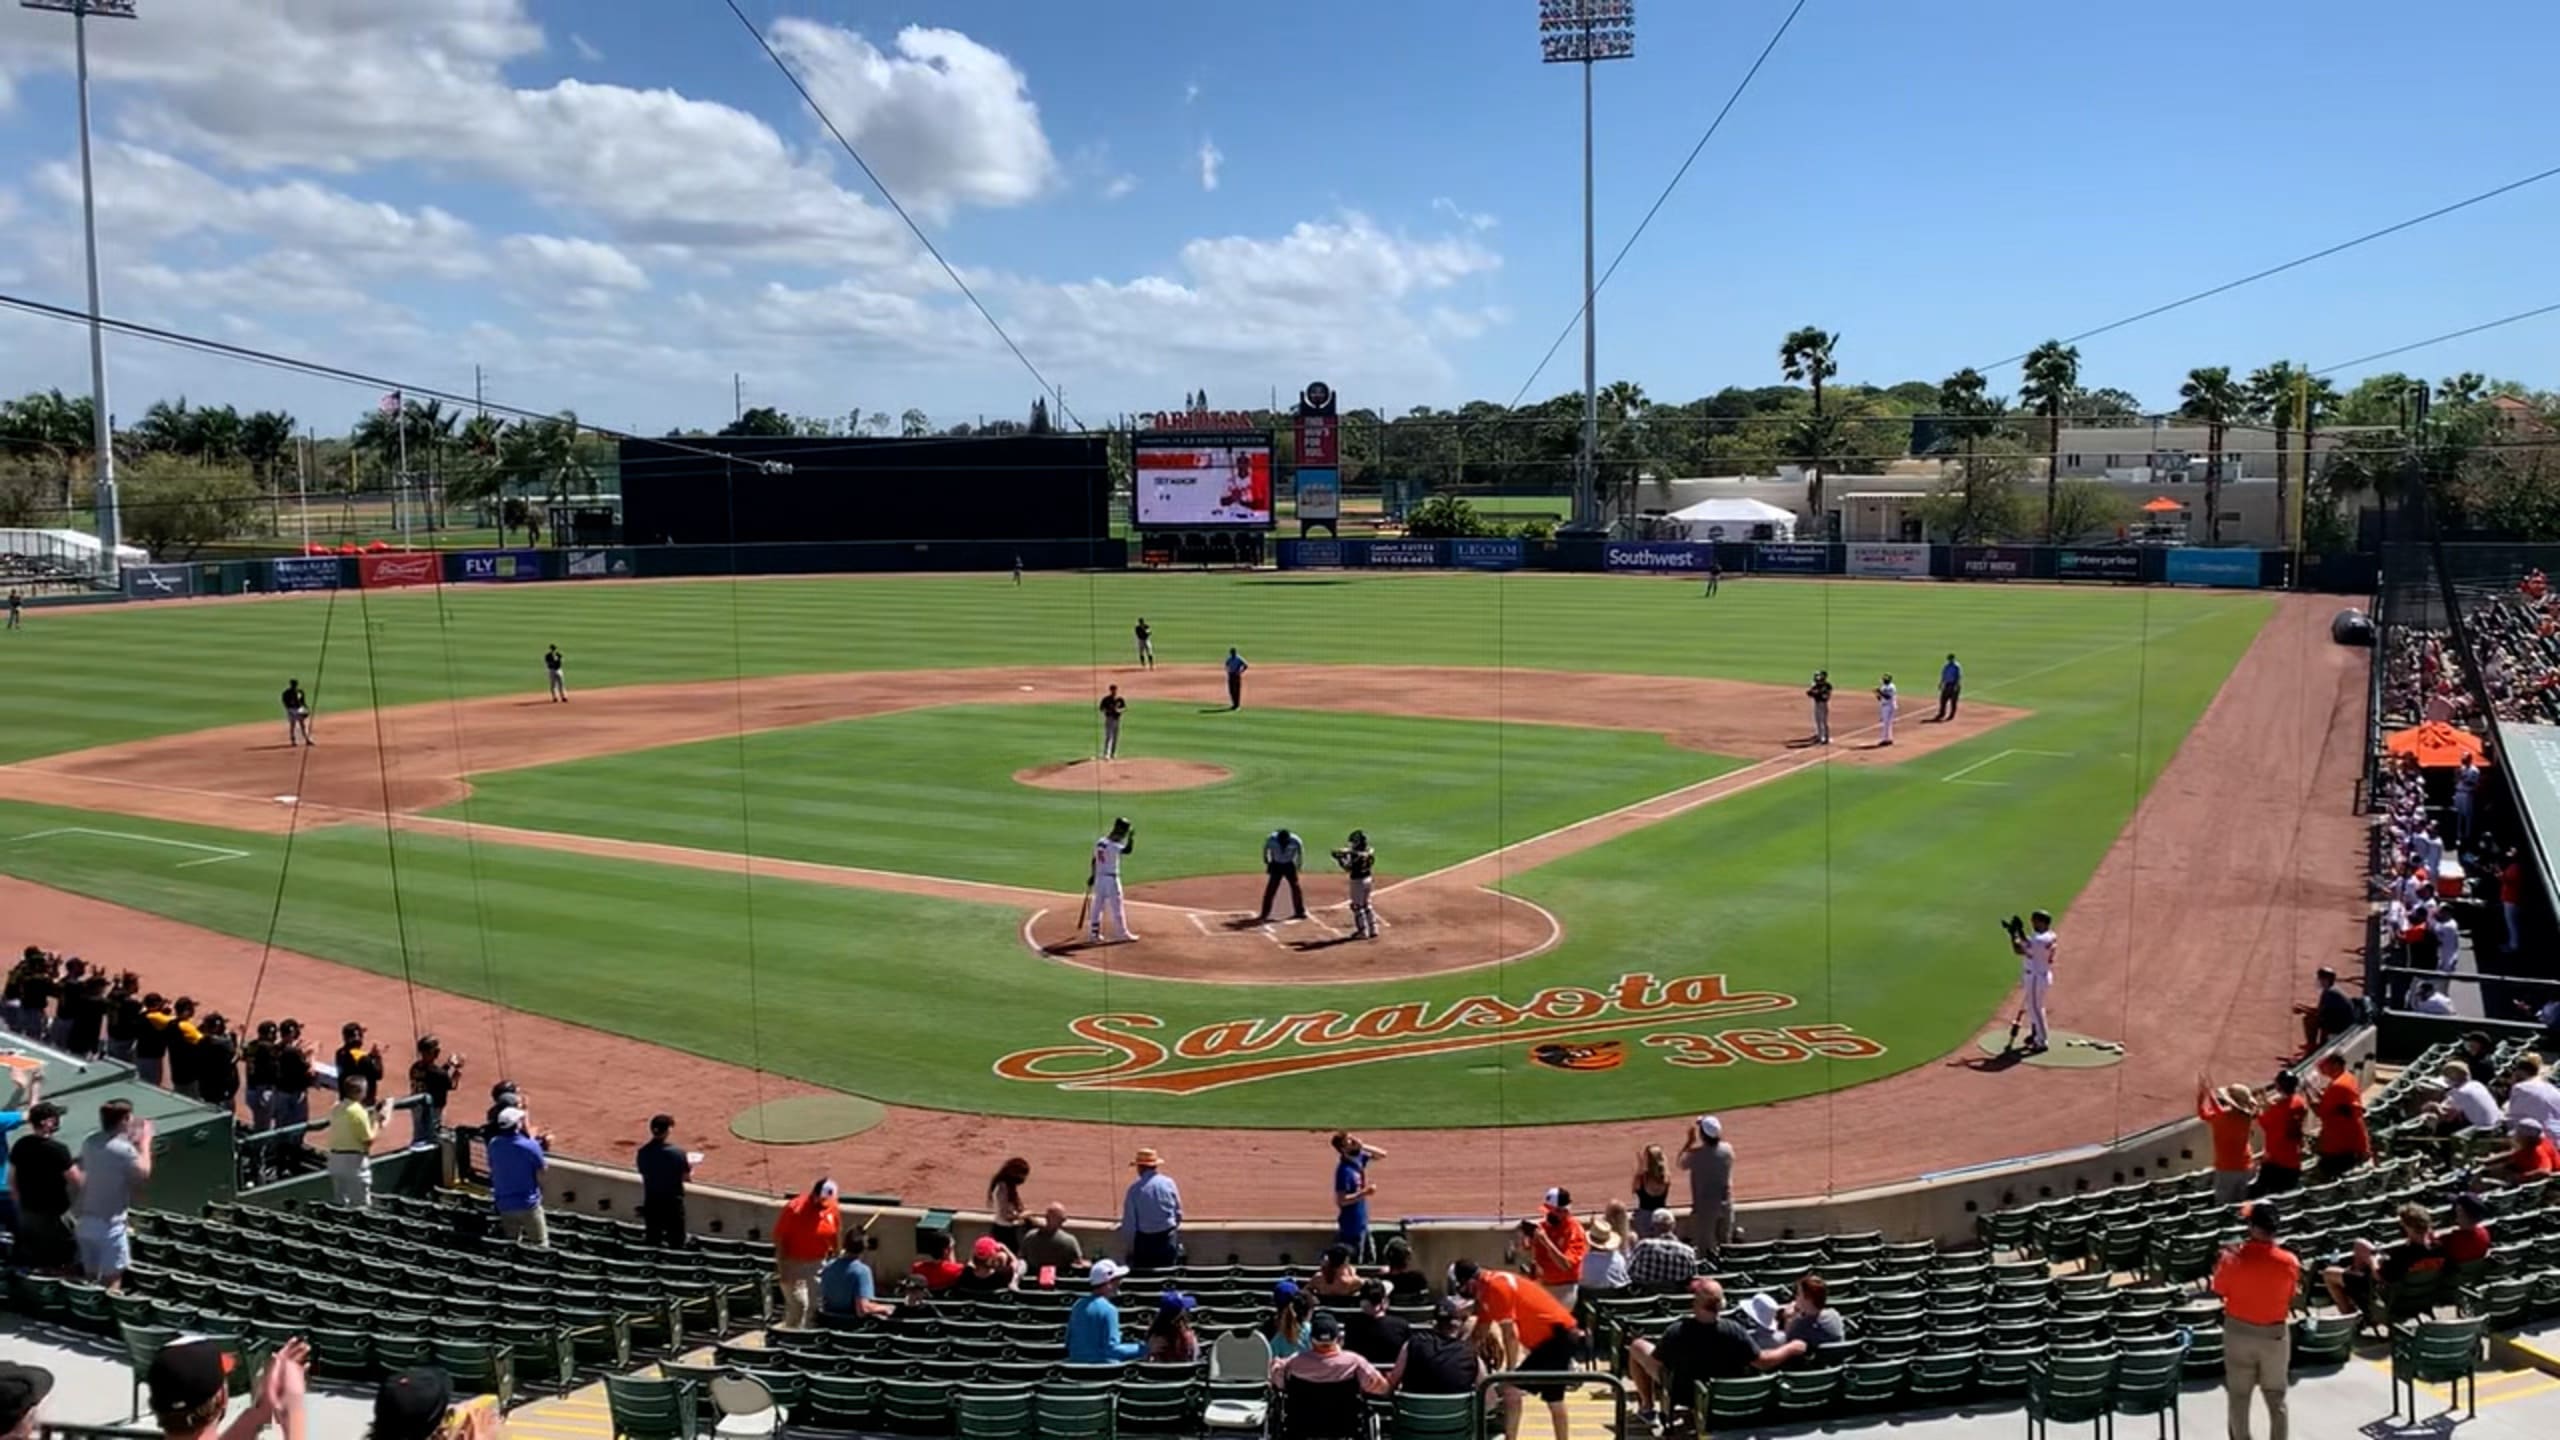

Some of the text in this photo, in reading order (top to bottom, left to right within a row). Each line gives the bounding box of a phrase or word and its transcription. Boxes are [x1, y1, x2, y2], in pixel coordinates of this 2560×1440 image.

[466, 559, 494, 574] FLY
[1609, 548, 1694, 567] Southwest
[1965, 561, 1989, 572] FIRST
[994, 972, 1797, 1094] Sarasota
[1642, 1023, 1888, 1068] 365
